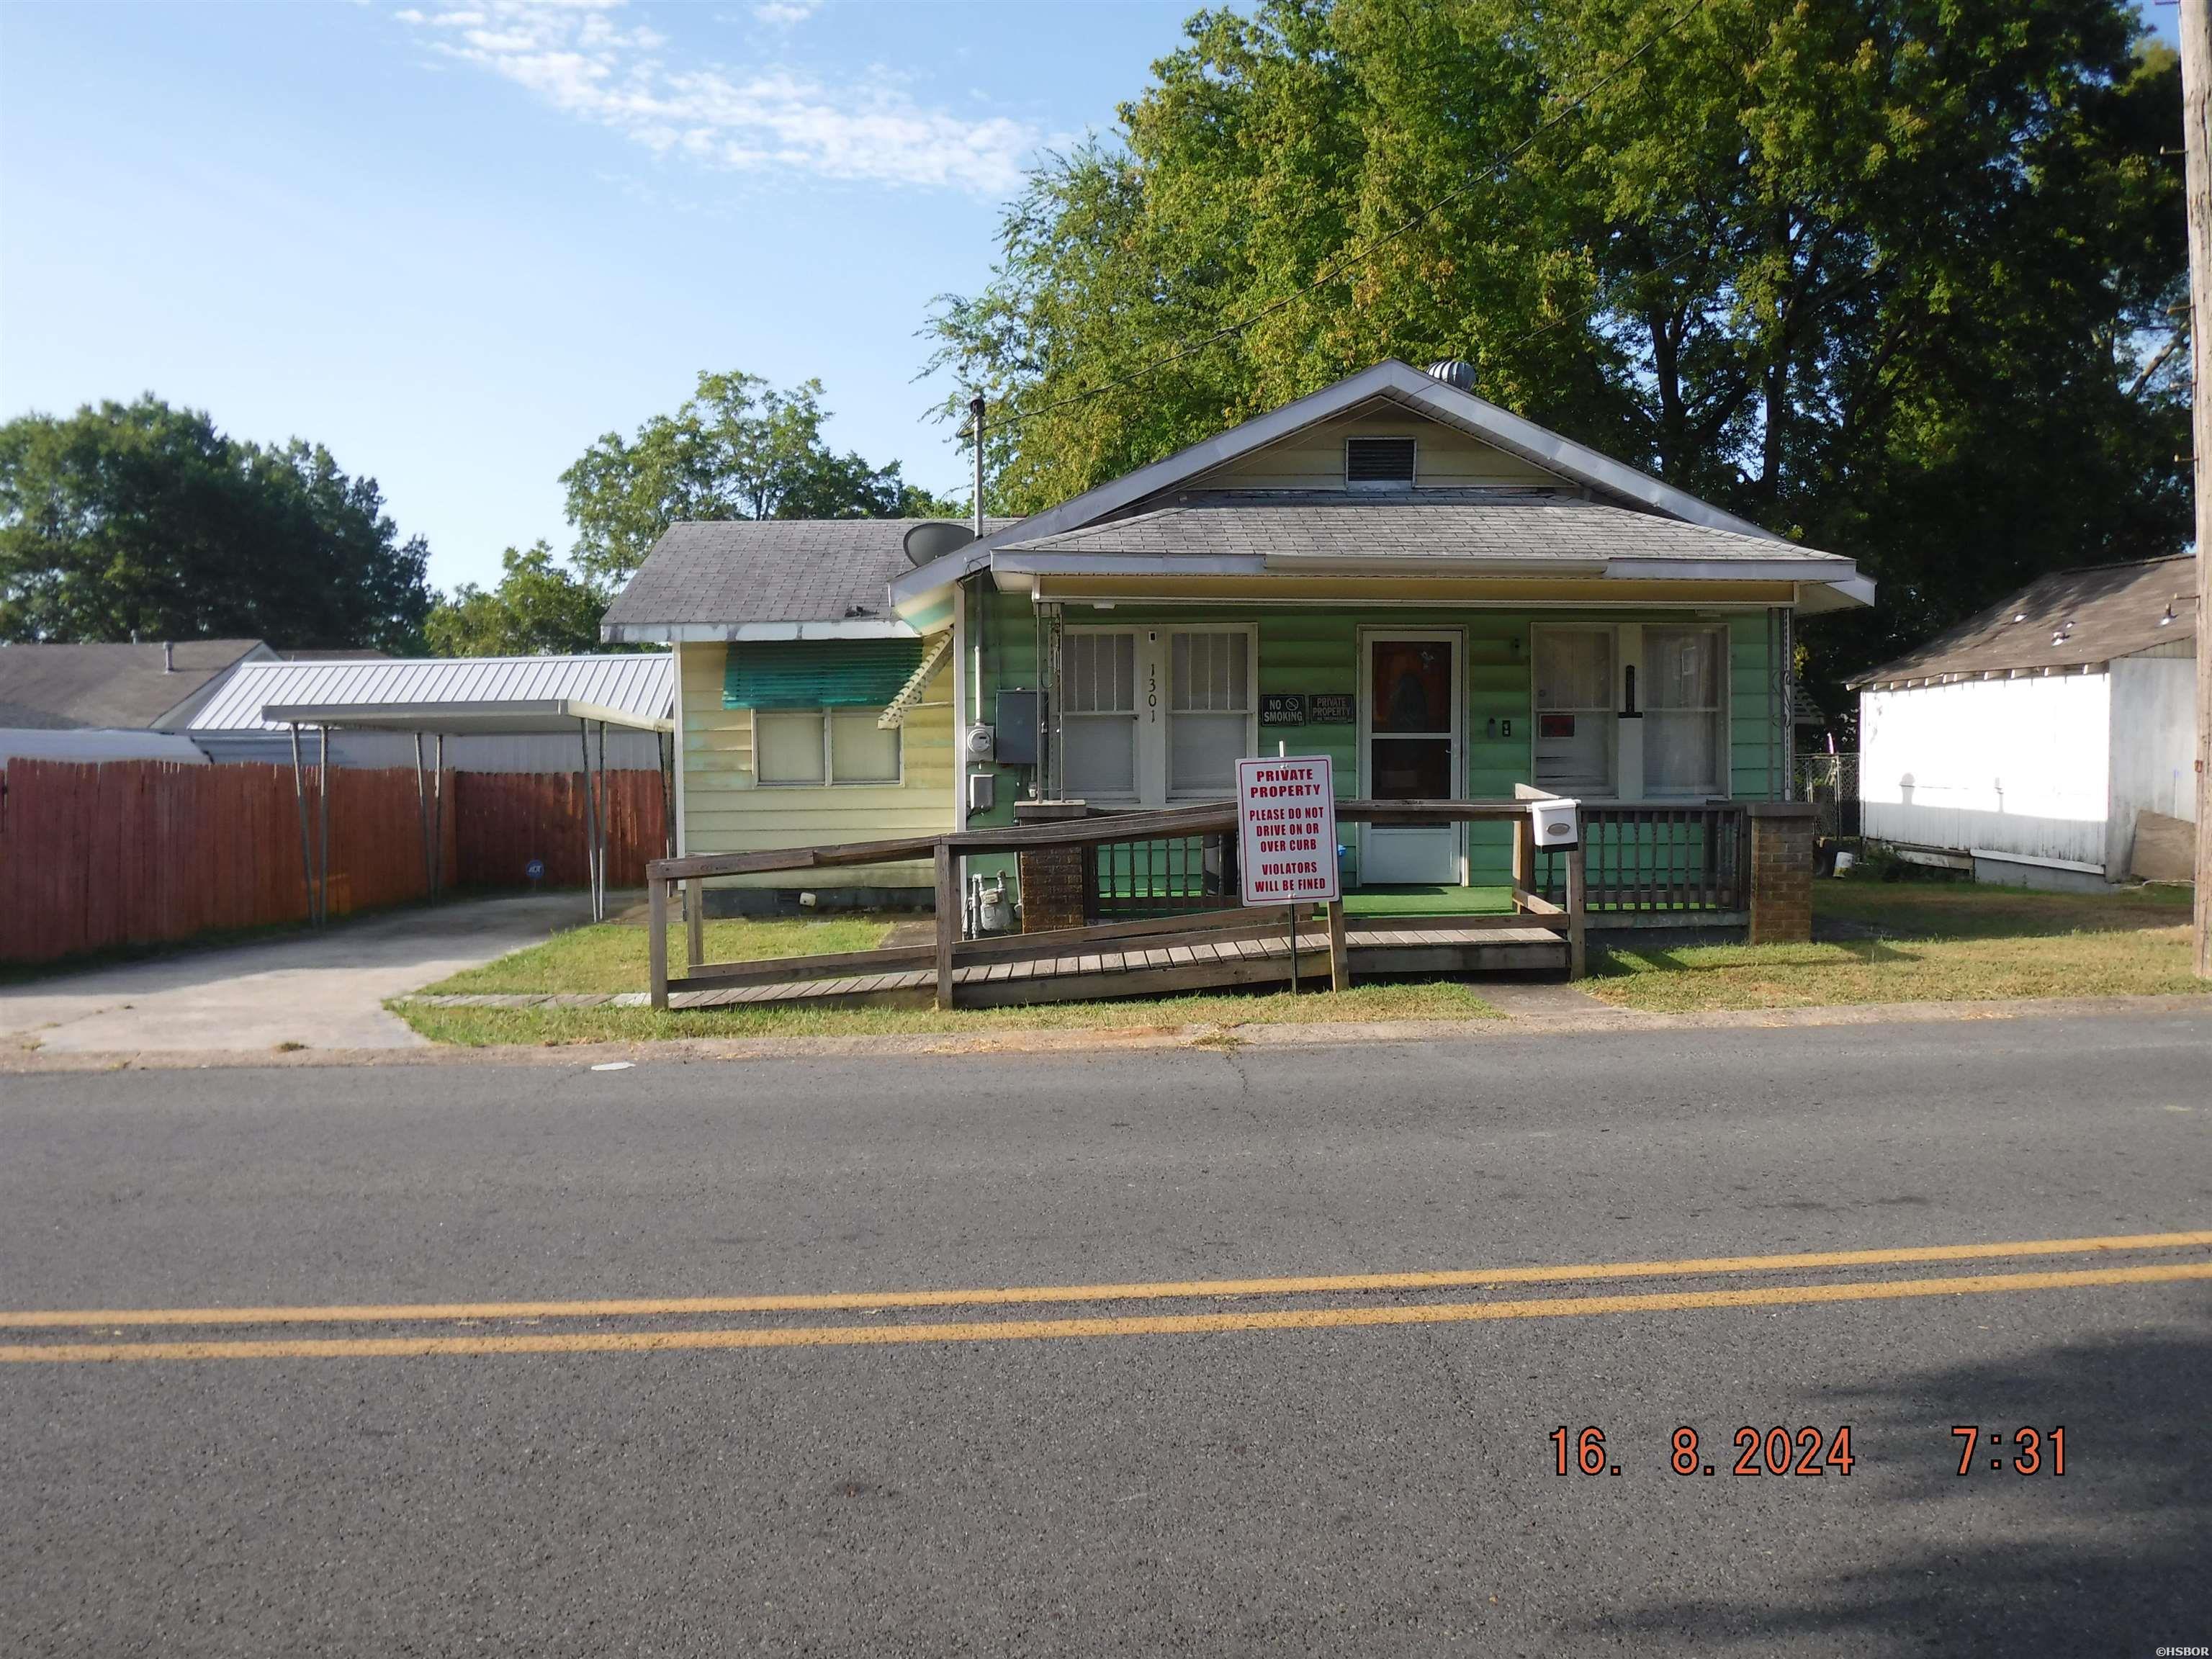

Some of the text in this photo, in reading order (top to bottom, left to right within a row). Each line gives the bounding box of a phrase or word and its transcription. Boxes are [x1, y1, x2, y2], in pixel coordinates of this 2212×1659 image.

[1269, 700, 1281, 710] NO
[1317, 697, 1346, 706] PRIVATE
[1264, 711, 1303, 721] SMOKING
[1256, 769, 1313, 782] PRIVATE
[1251, 784, 1321, 798] PROPERTY
[1250, 807, 1324, 821] PLEASE DO NOT
[1256, 823, 1319, 837] DRIVE ON OR
[1260, 839, 1316, 853] OVER CURB
[1262, 862, 1317, 876] VIOLATORS
[1255, 878, 1326, 892] WILL BE FINED
